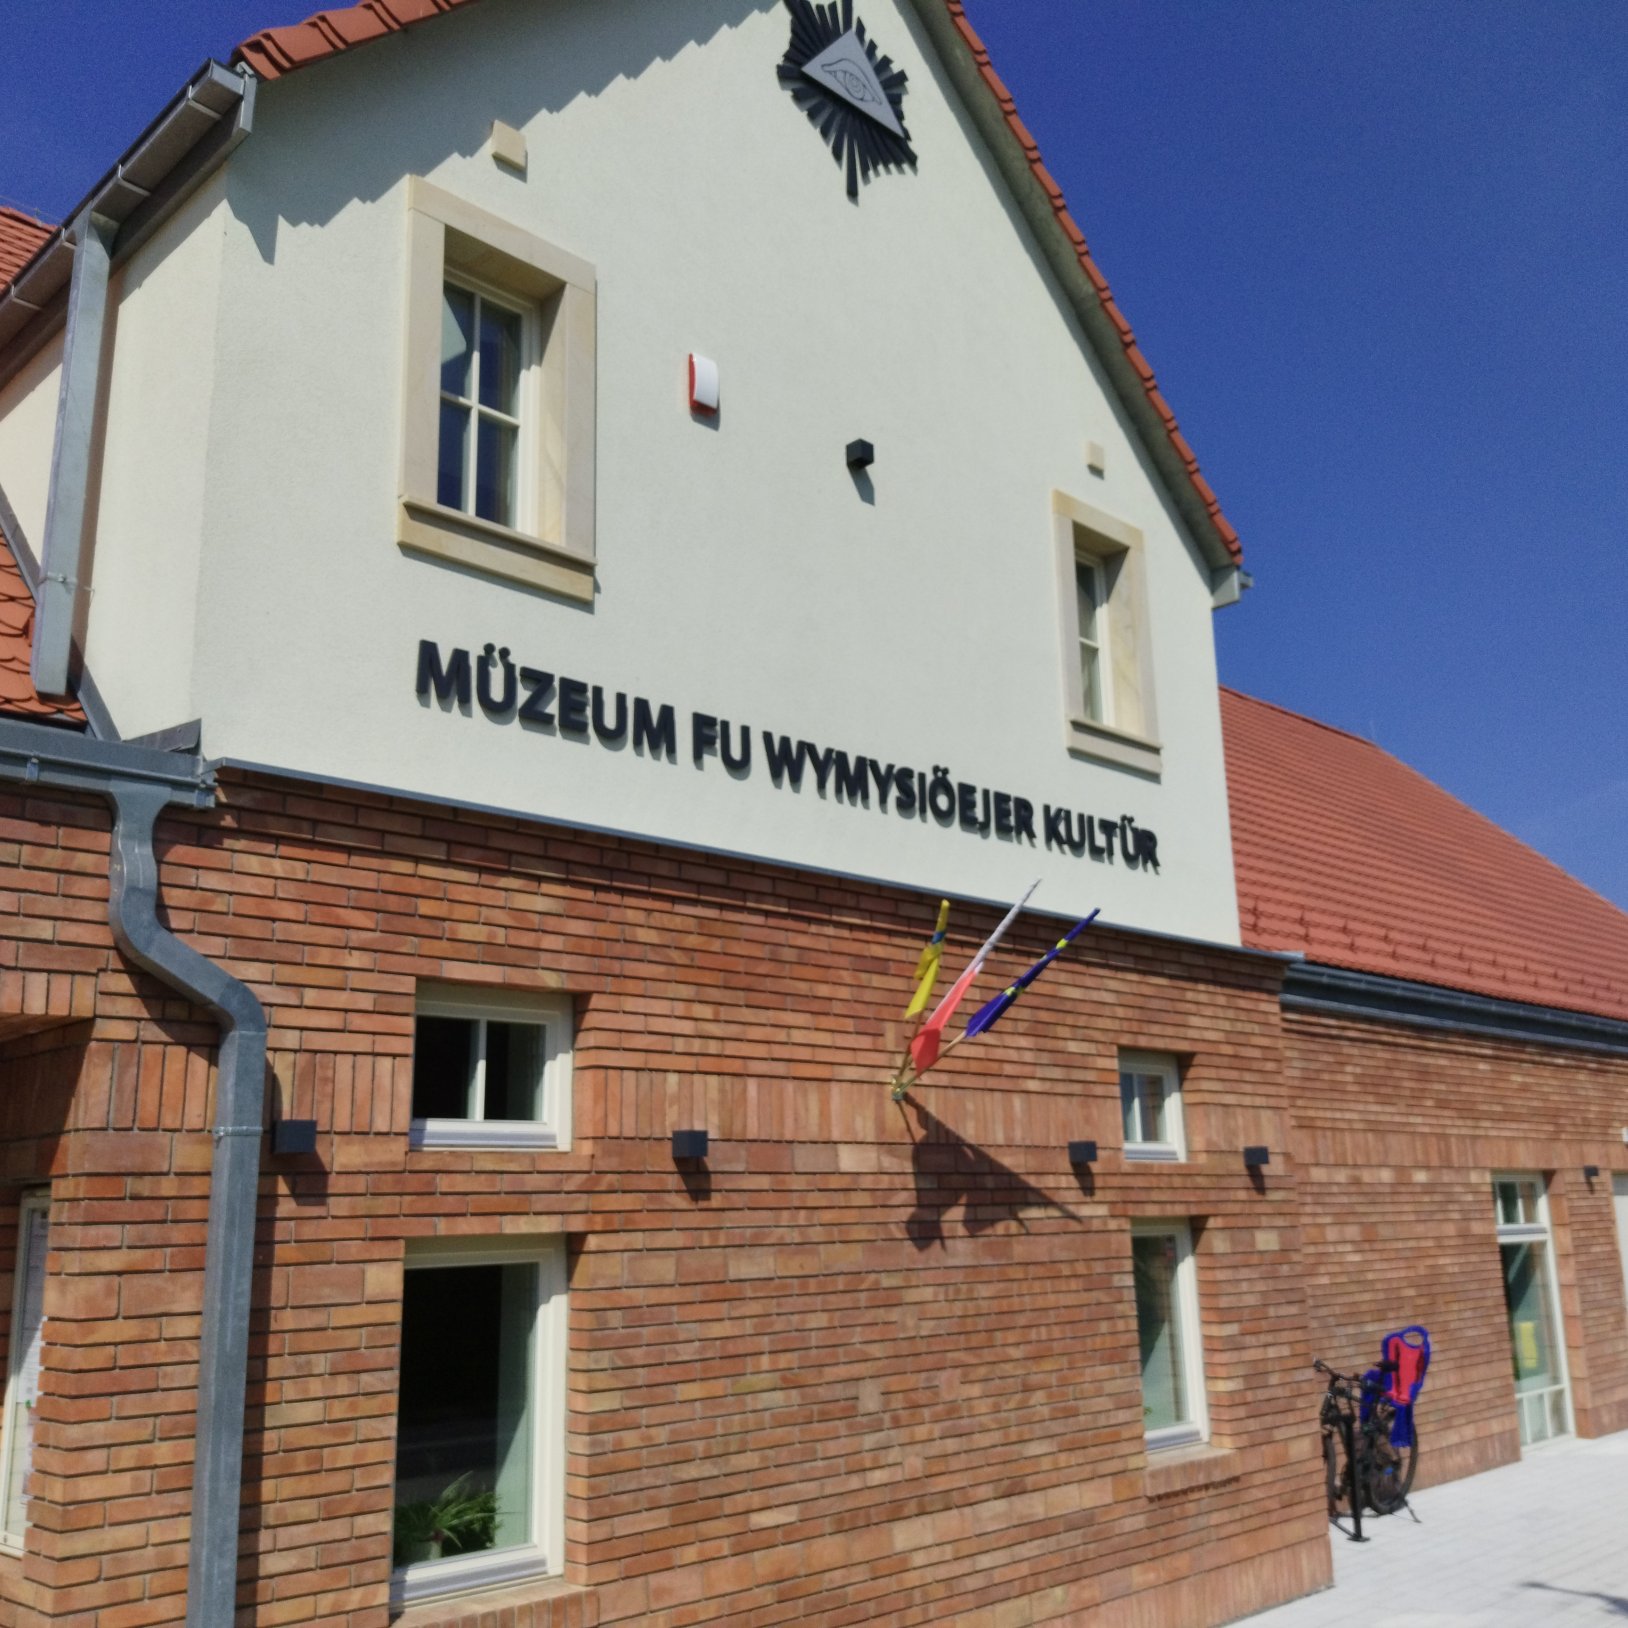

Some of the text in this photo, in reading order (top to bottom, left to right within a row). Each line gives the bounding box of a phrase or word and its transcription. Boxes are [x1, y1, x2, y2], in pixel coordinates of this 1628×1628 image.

[416, 639, 1160, 867] MÜZEUM FU WYMYSIÖEJER KULTÜR
